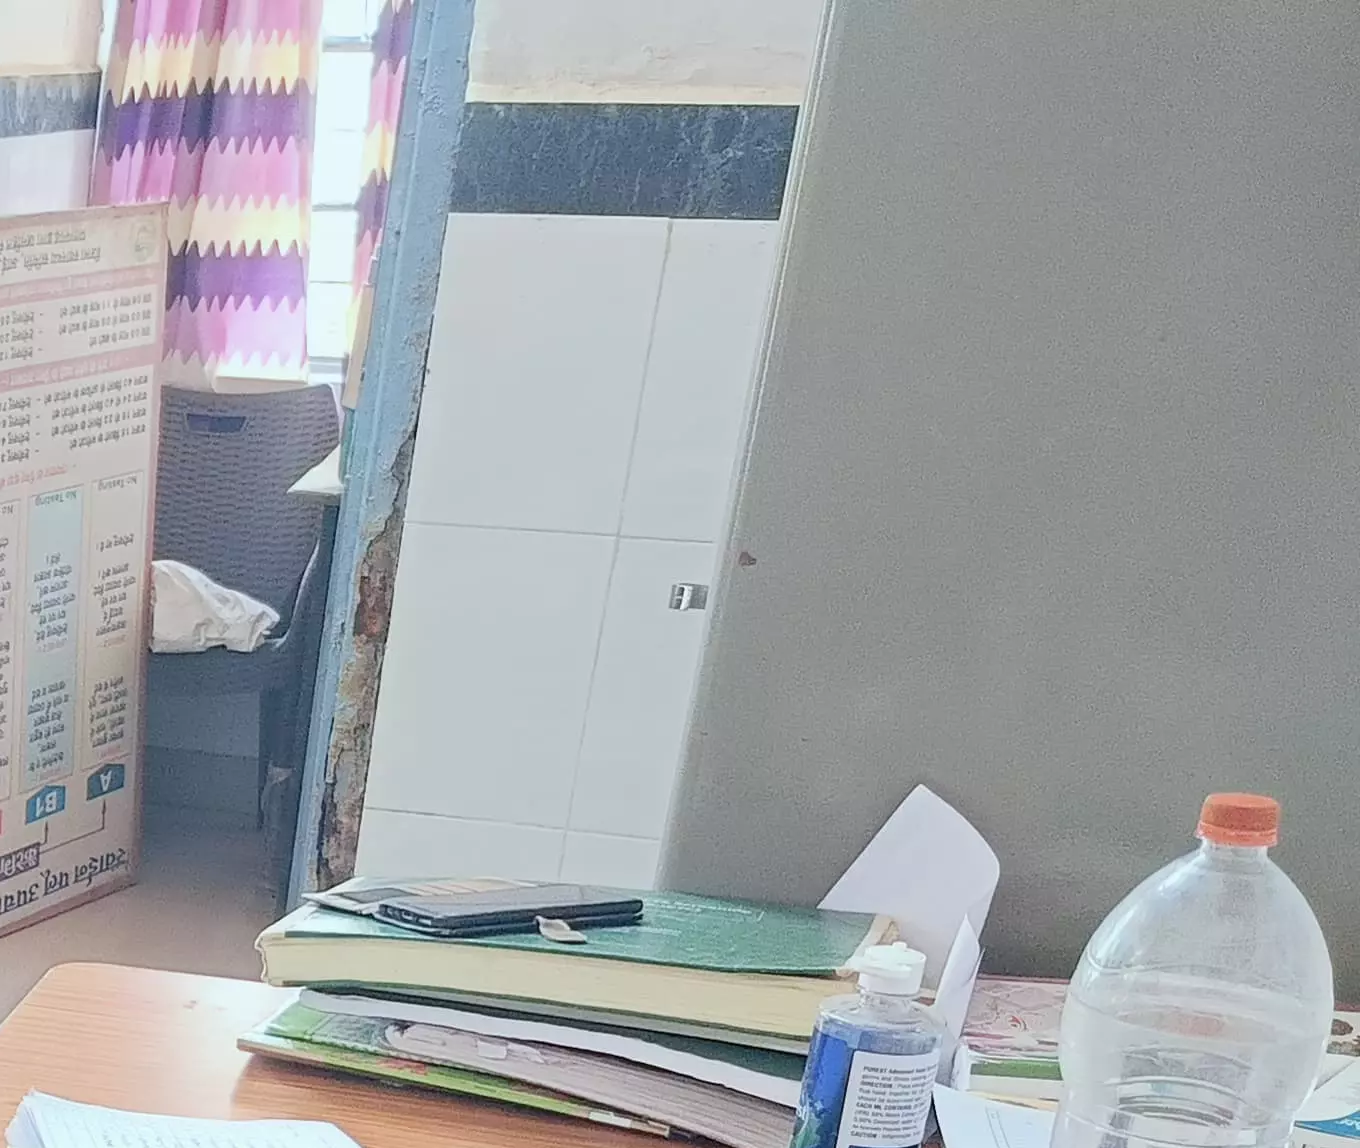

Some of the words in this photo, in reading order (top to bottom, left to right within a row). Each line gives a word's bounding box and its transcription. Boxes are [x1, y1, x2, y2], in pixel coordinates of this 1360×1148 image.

[1, 504, 12, 514] No
[98, 771, 112, 791] A
[35, 792, 56, 815] B1
